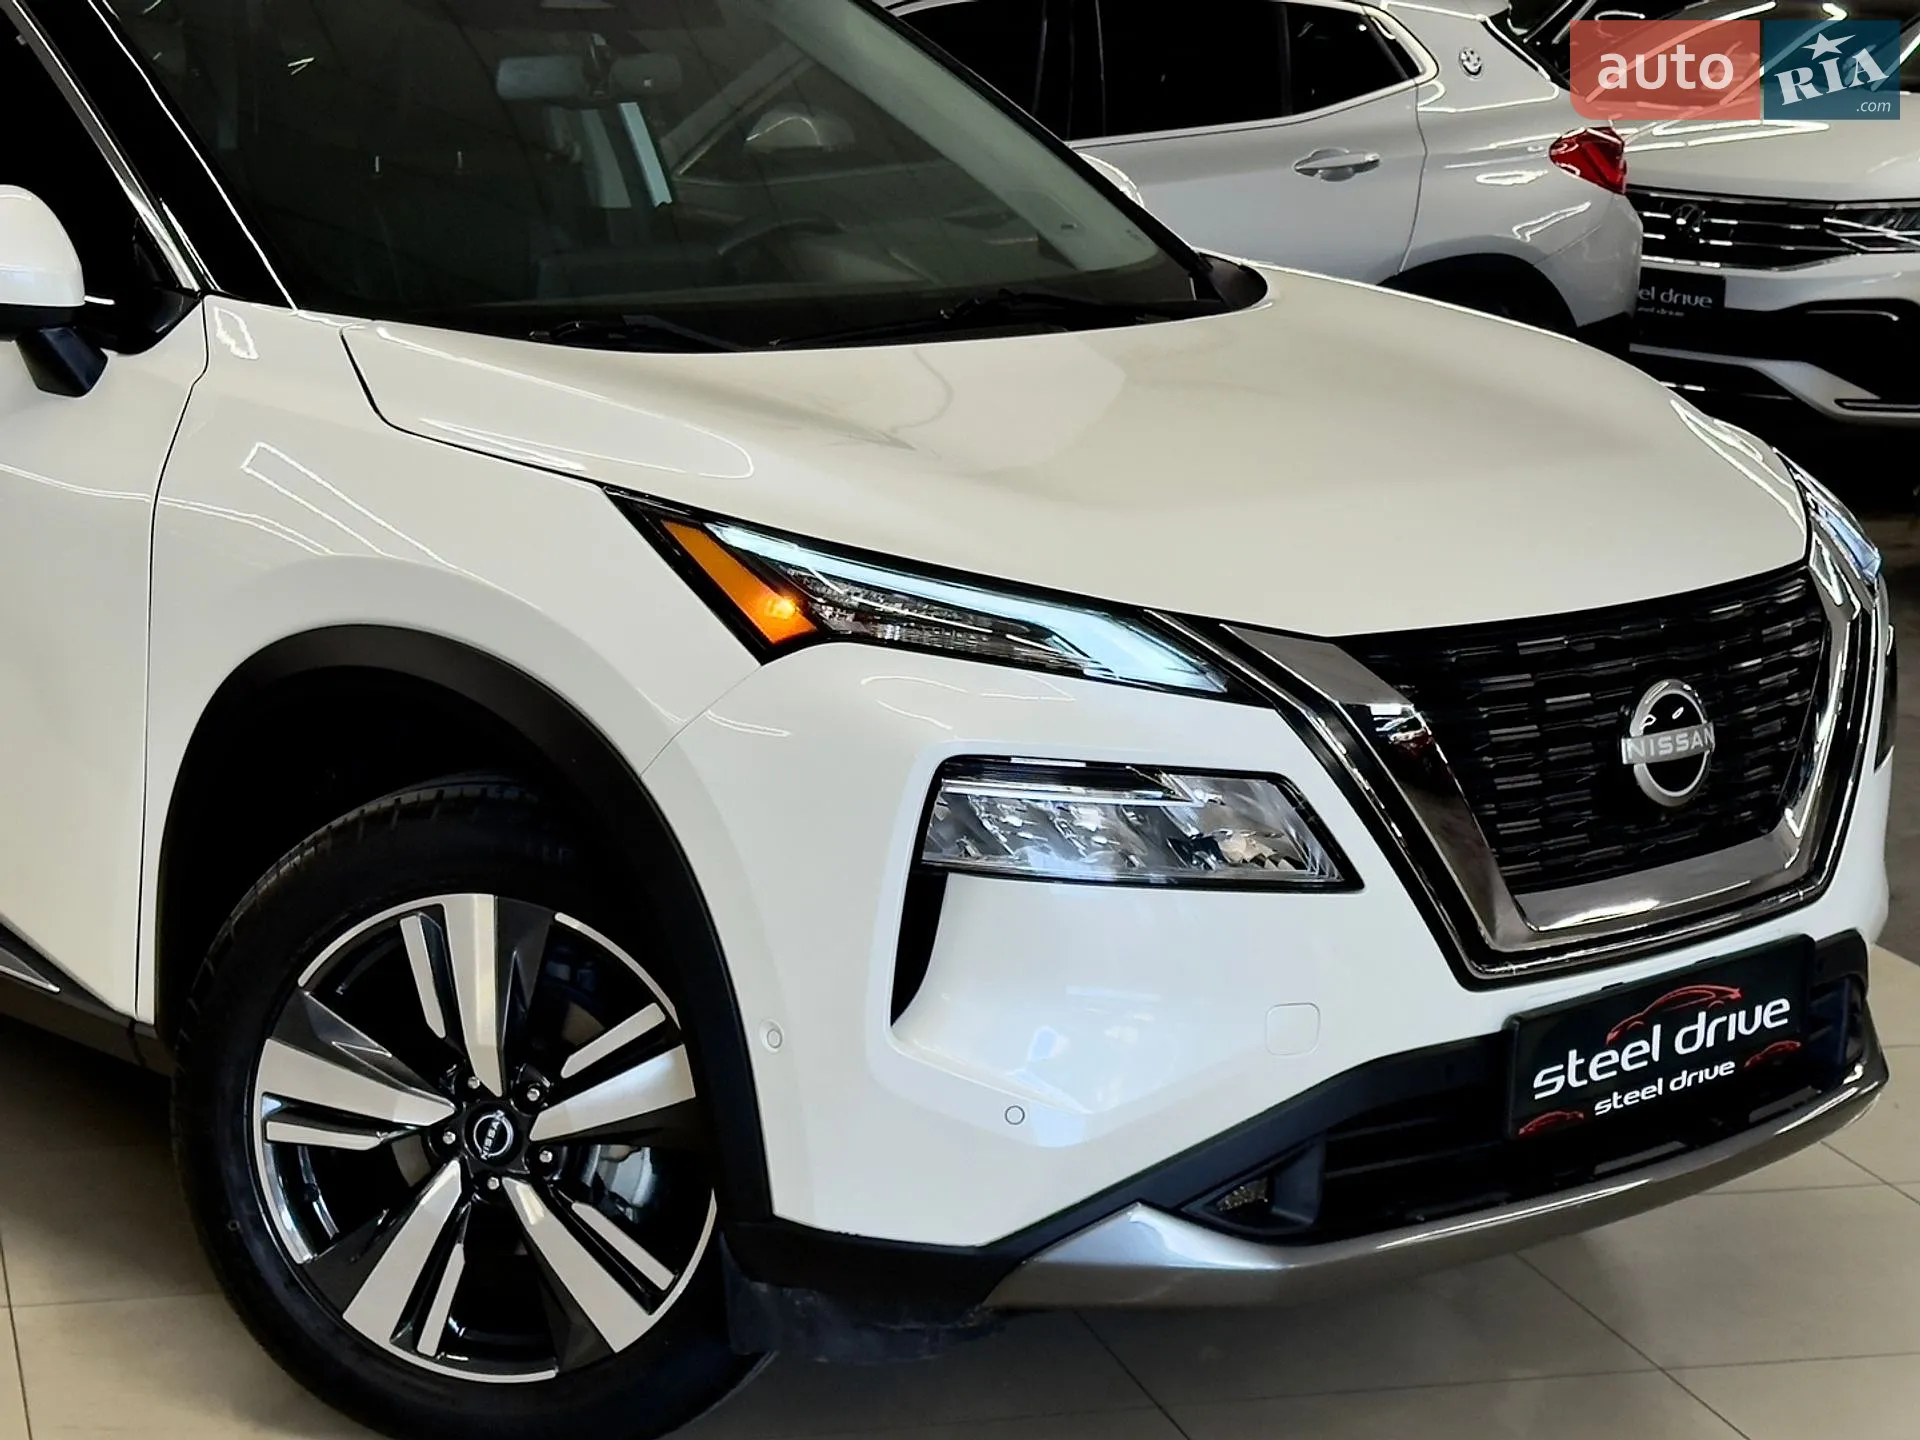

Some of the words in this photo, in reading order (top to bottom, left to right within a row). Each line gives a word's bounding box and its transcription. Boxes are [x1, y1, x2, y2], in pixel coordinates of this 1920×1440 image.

[1660, 288, 1713, 308] drive
[1625, 725, 1715, 759] NISSAN
[1534, 1024, 1661, 1100] steel
[1674, 998, 1791, 1055] drive
[1594, 1078, 1663, 1115] steel
[1669, 1061, 1735, 1091] drive
